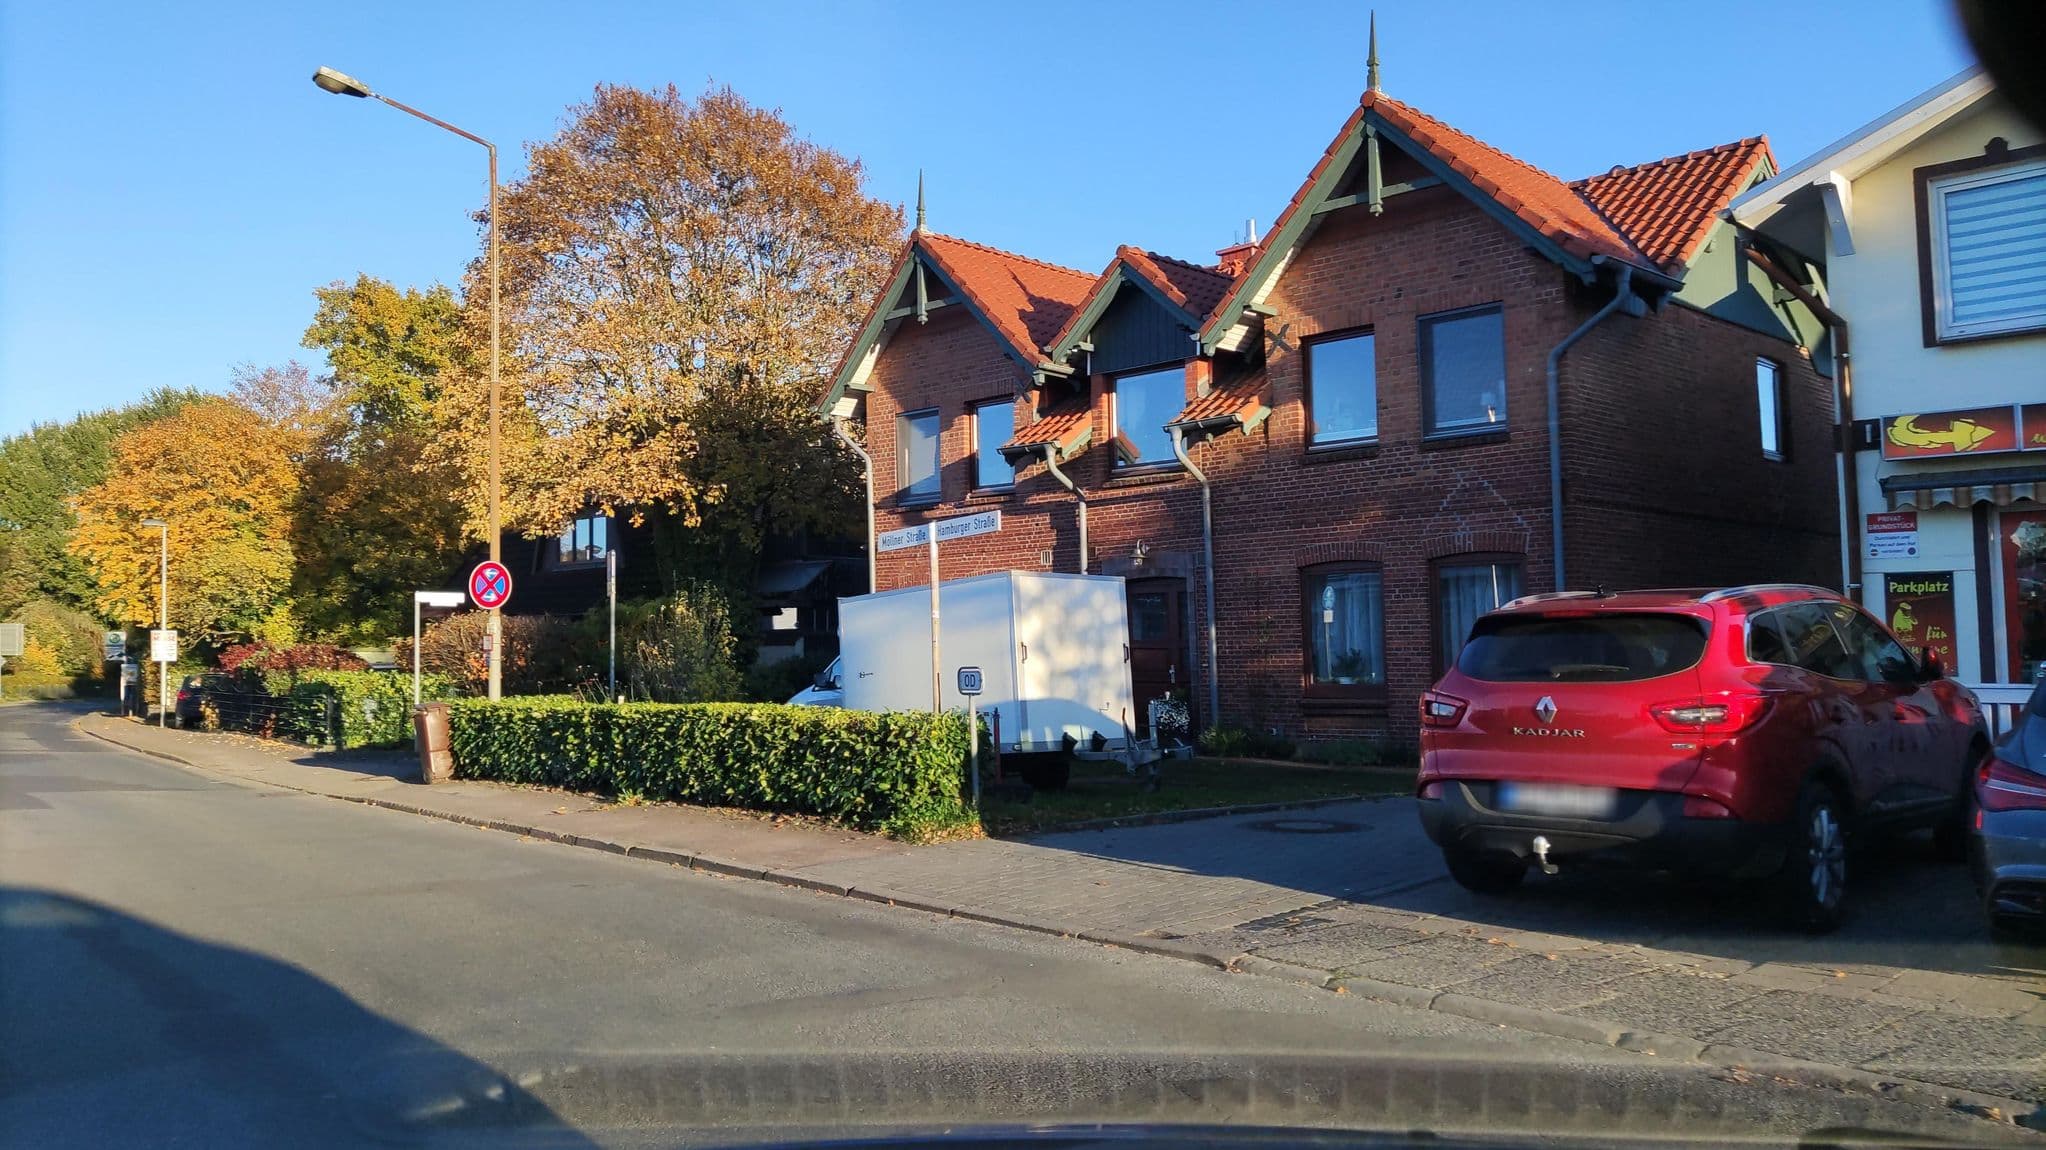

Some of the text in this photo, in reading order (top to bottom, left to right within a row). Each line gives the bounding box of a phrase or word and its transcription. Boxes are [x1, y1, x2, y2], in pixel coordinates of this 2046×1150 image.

[937, 515, 995, 537] Hamburger Straße
[881, 529, 926, 547] Möllner Straße
[1889, 581, 1950, 596] Parkplatz
[1926, 624, 1948, 641] für
[964, 674, 976, 688] OD
[1513, 727, 1585, 738] KADJAR
